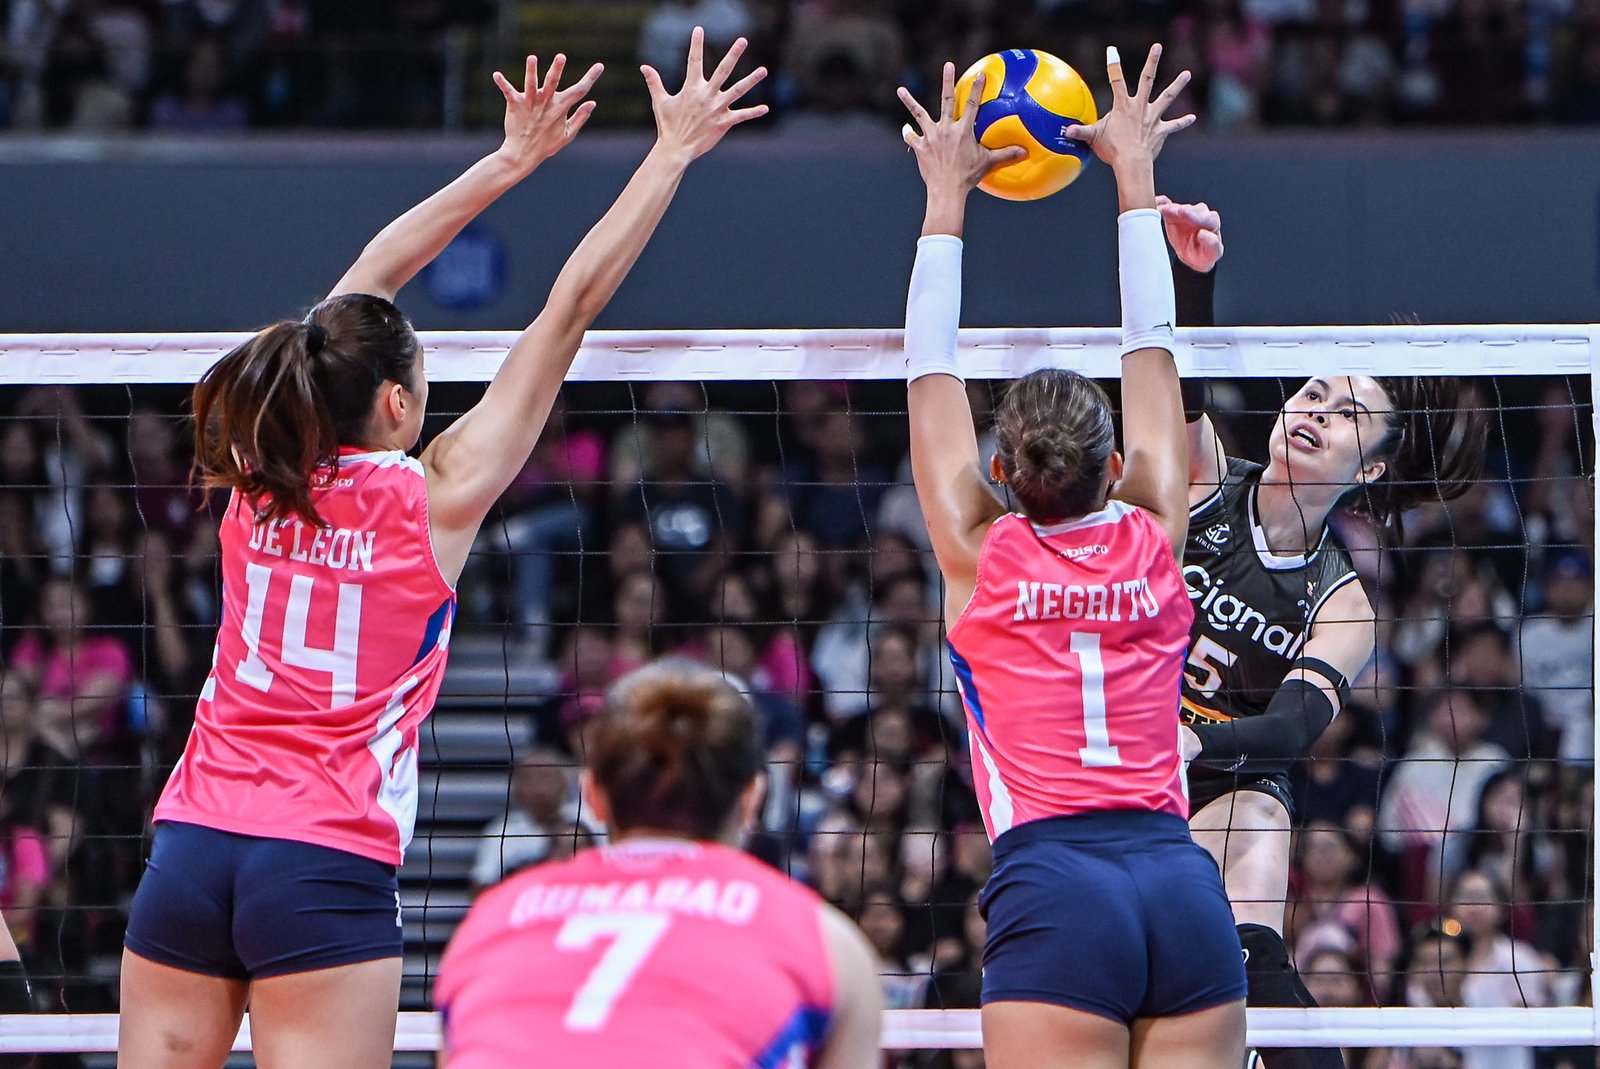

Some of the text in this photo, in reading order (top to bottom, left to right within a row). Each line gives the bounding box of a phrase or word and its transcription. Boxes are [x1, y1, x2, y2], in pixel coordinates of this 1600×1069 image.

[249, 517, 377, 571] DE LEON
[234, 561, 363, 710] 14
[1013, 577, 1160, 622] NEGRITO
[1182, 564, 1304, 660] Cignal
[1069, 631, 1122, 768] 1
[1183, 633, 1239, 700] 5
[554, 912, 673, 1032] 7
